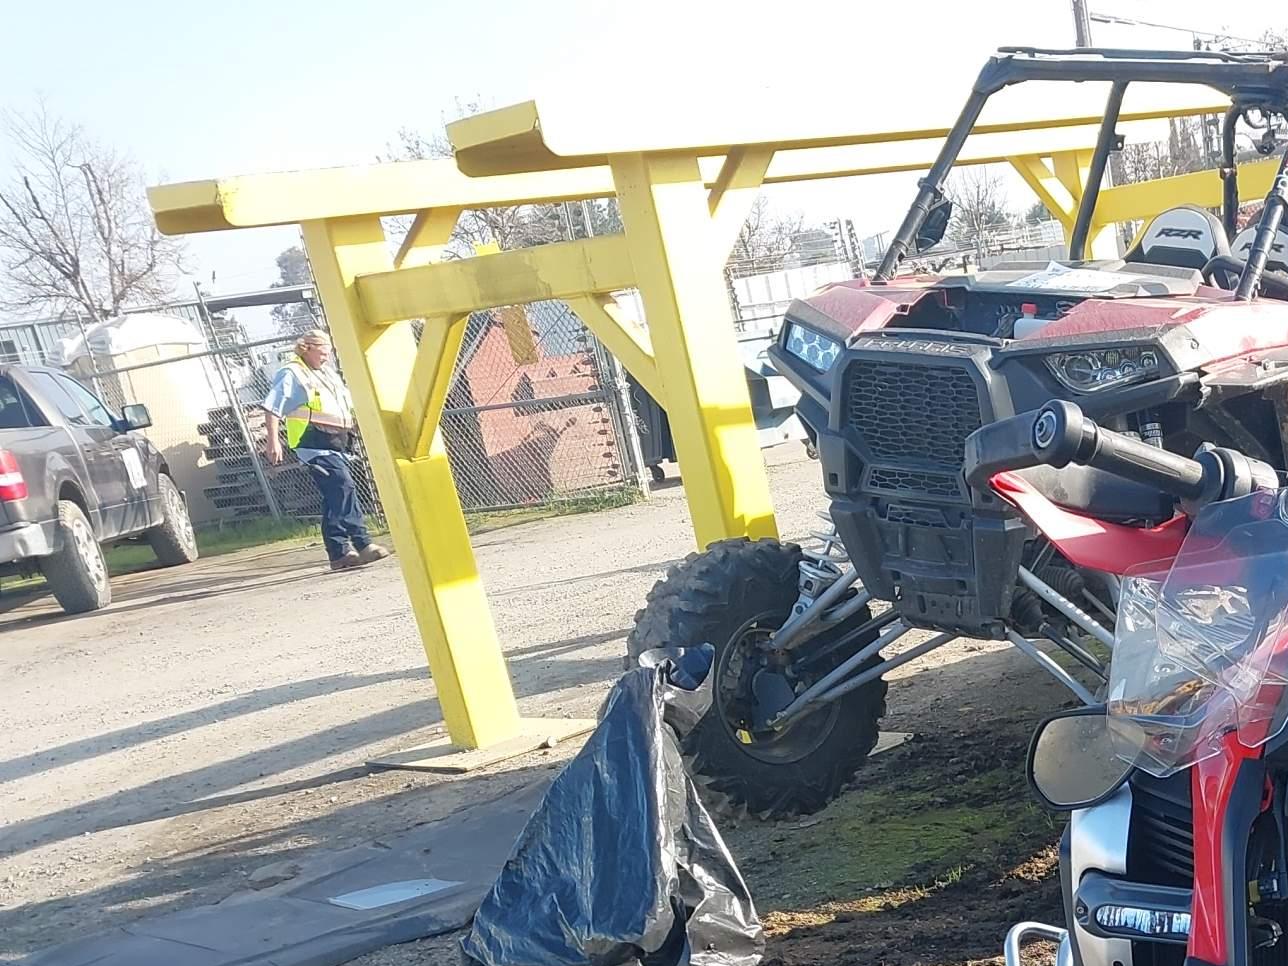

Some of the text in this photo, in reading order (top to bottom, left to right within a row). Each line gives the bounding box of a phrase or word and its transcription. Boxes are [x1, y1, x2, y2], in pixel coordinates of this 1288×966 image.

[1155, 227, 1204, 240] RZR
[1239, 242, 1285, 253] RR
[863, 338, 970, 354] POLARIS
